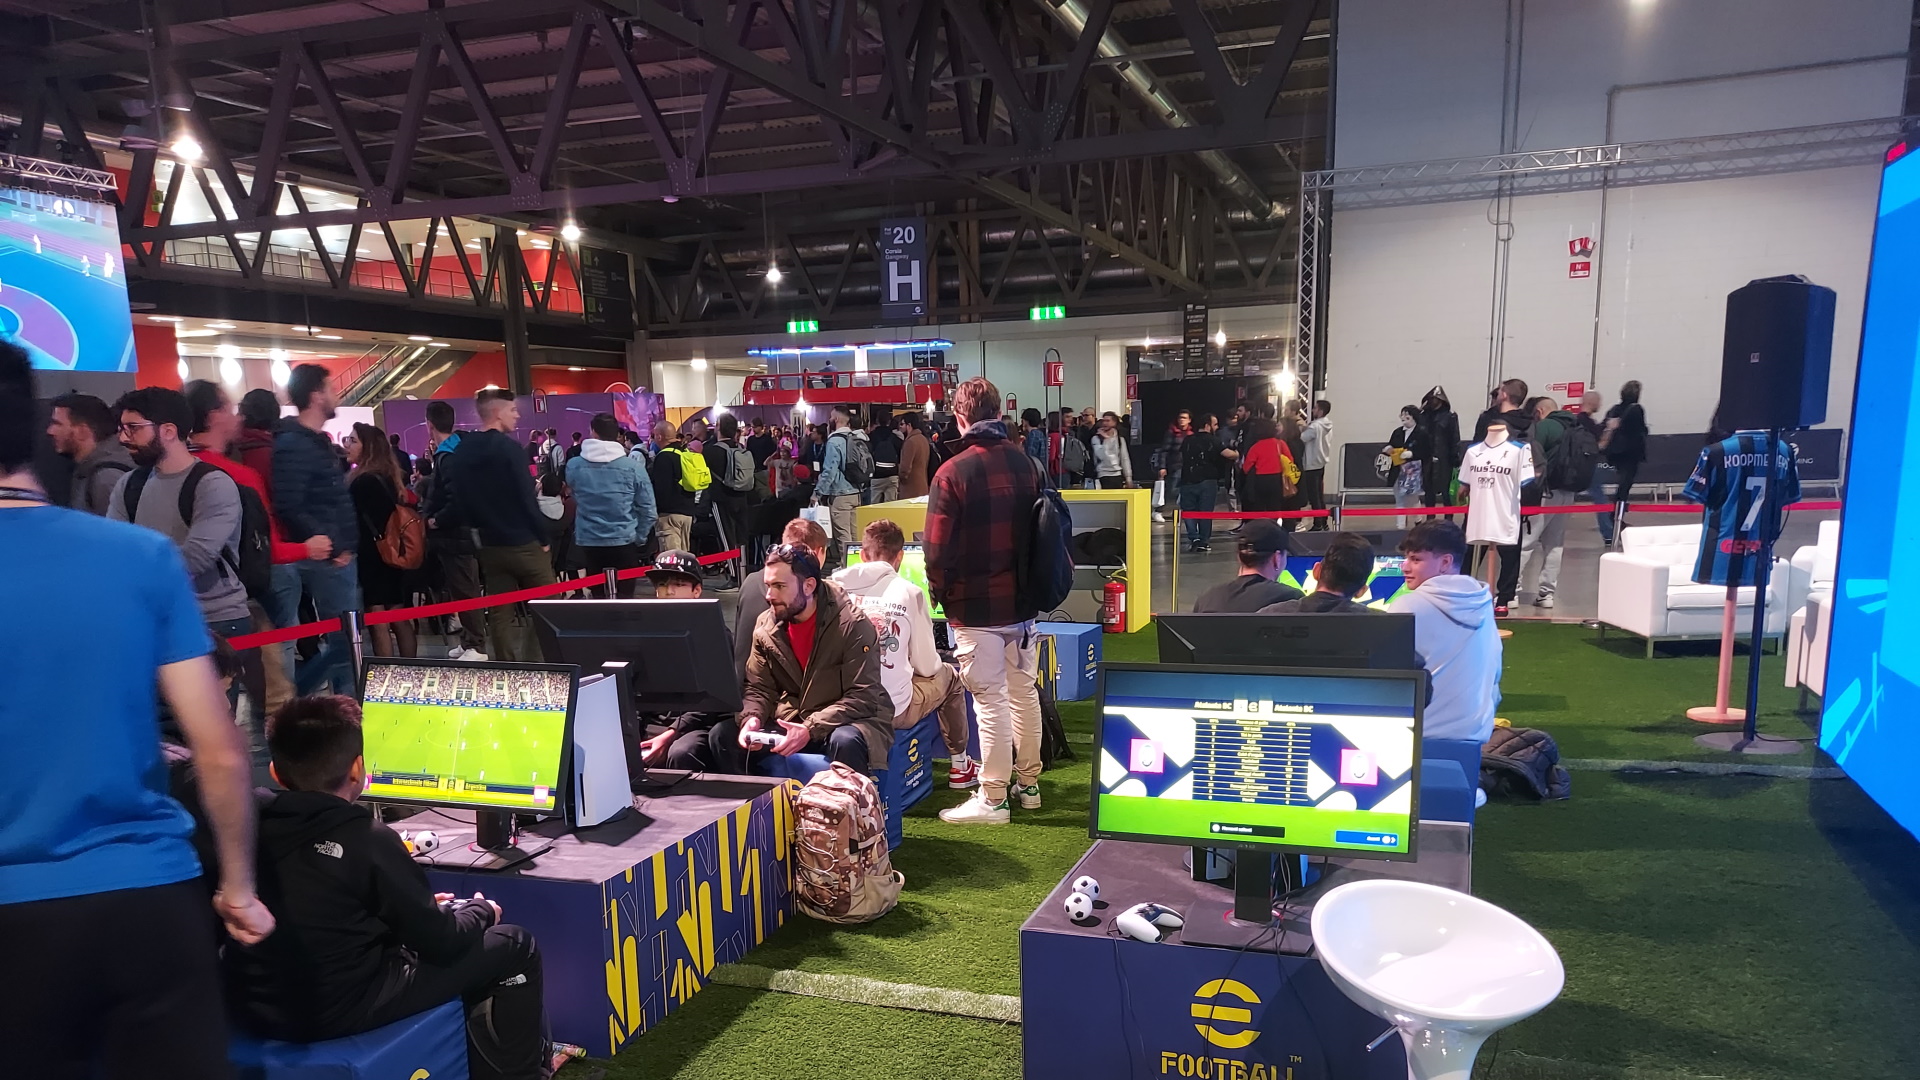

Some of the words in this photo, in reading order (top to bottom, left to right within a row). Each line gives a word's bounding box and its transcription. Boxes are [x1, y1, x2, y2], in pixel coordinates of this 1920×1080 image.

[893, 226, 916, 244] 20
[889, 260, 920, 301] H
[1740, 476, 1767, 531] 7
